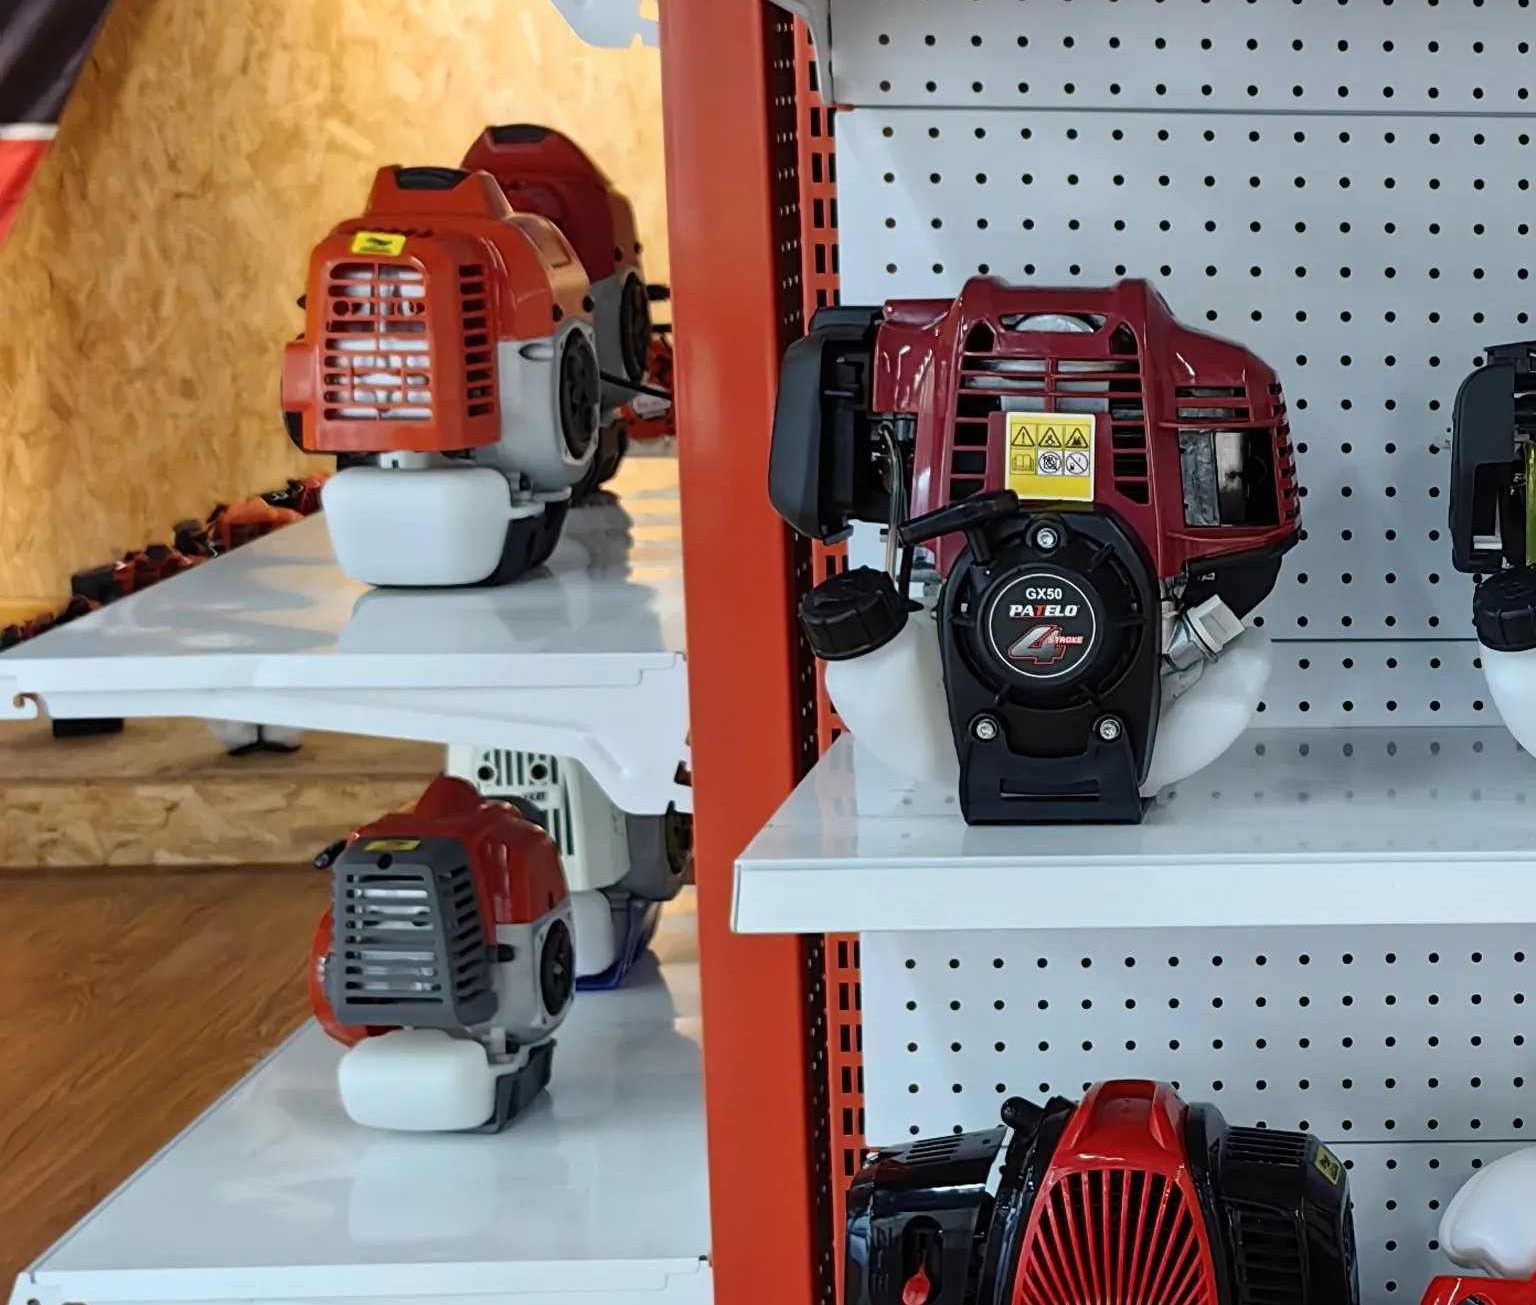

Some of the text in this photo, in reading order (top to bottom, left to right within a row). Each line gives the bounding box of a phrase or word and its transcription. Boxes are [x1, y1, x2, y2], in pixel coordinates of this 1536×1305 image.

[1025, 587, 1063, 600] GX50
[1009, 604, 1079, 618] PATELO
[1007, 624, 1084, 665] 4 STROKE
